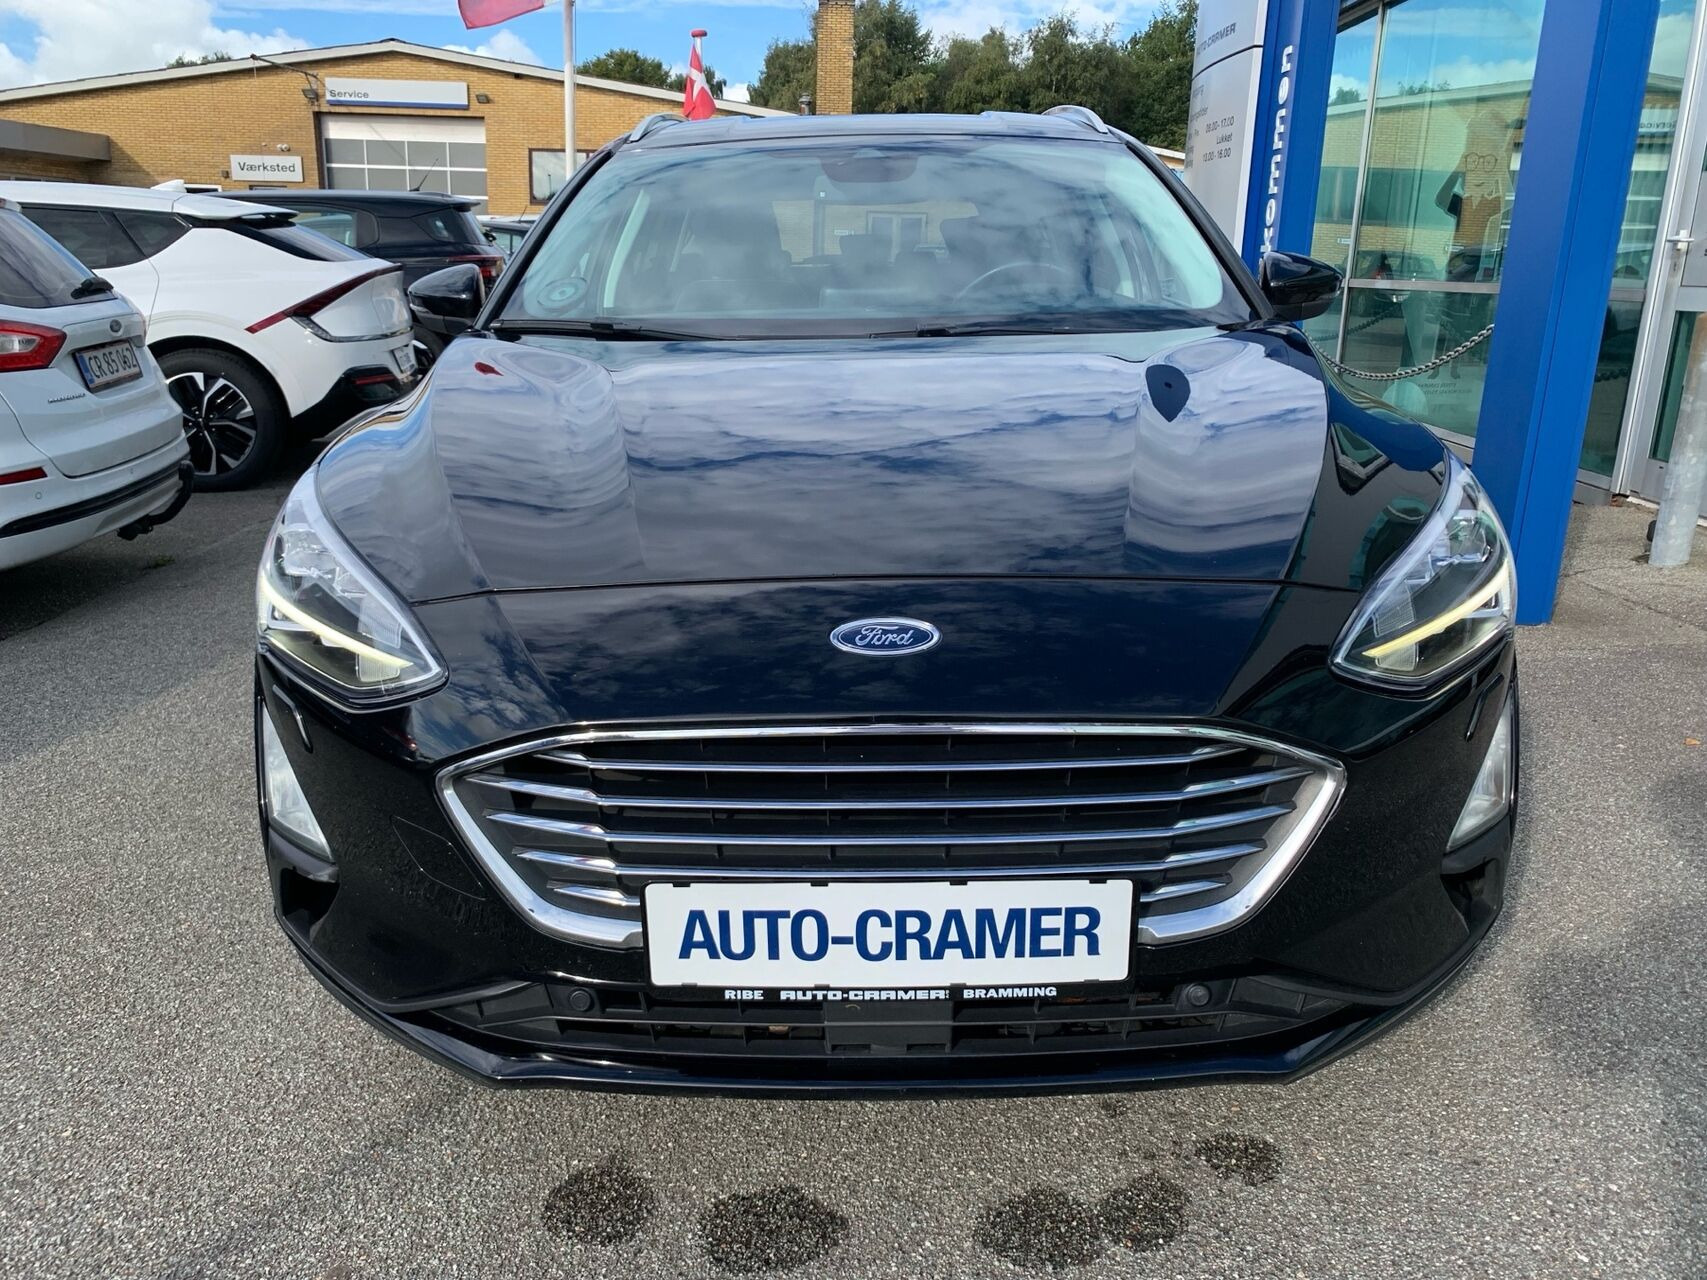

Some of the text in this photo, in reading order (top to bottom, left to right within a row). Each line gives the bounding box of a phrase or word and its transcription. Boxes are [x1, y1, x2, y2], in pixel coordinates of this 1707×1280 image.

[329, 89, 369, 99] Service
[1259, 45, 1293, 254] kommen
[238, 161, 296, 173] Værksted
[88, 347, 138, 379] CR 85 062
[855, 625, 915, 646] Ford
[679, 906, 1101, 962] AUTO-CRAMER
[724, 989, 764, 1000] RIBE
[780, 989, 946, 1000] AUTO-CRAMER
[963, 986, 1057, 999] BRAMMING
